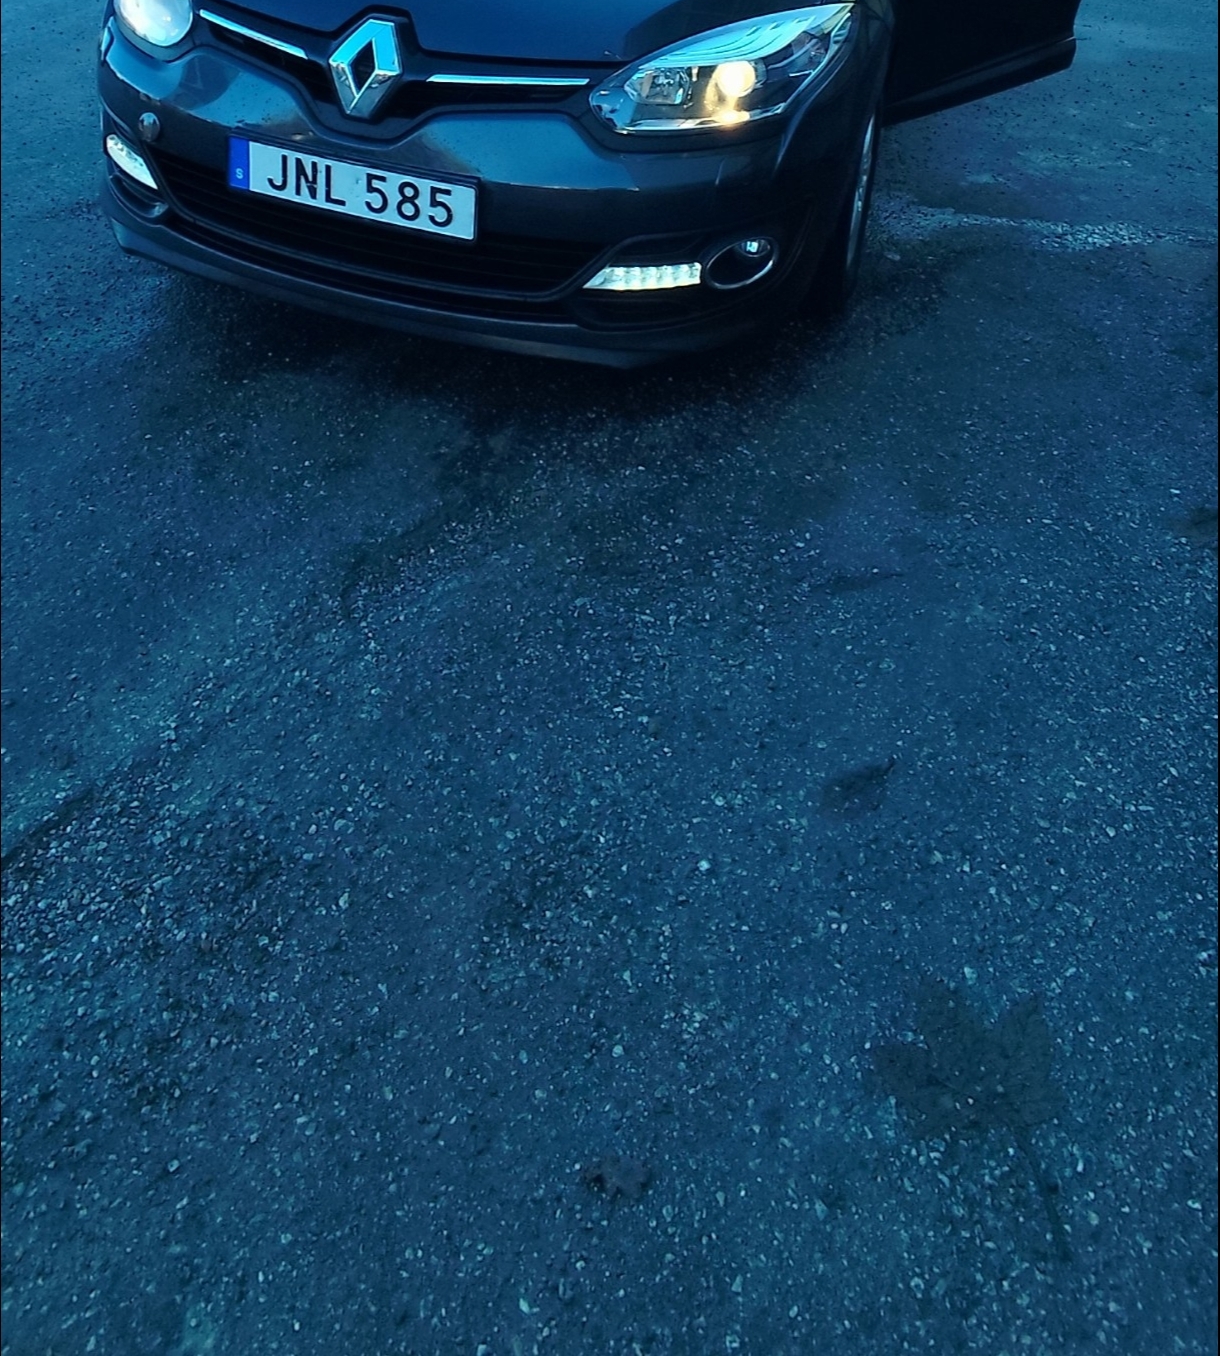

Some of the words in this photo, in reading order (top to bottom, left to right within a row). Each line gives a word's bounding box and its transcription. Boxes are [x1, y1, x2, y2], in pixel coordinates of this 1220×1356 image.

[235, 167, 244, 180] S
[266, 154, 347, 207] JNL
[364, 172, 453, 227] 585
